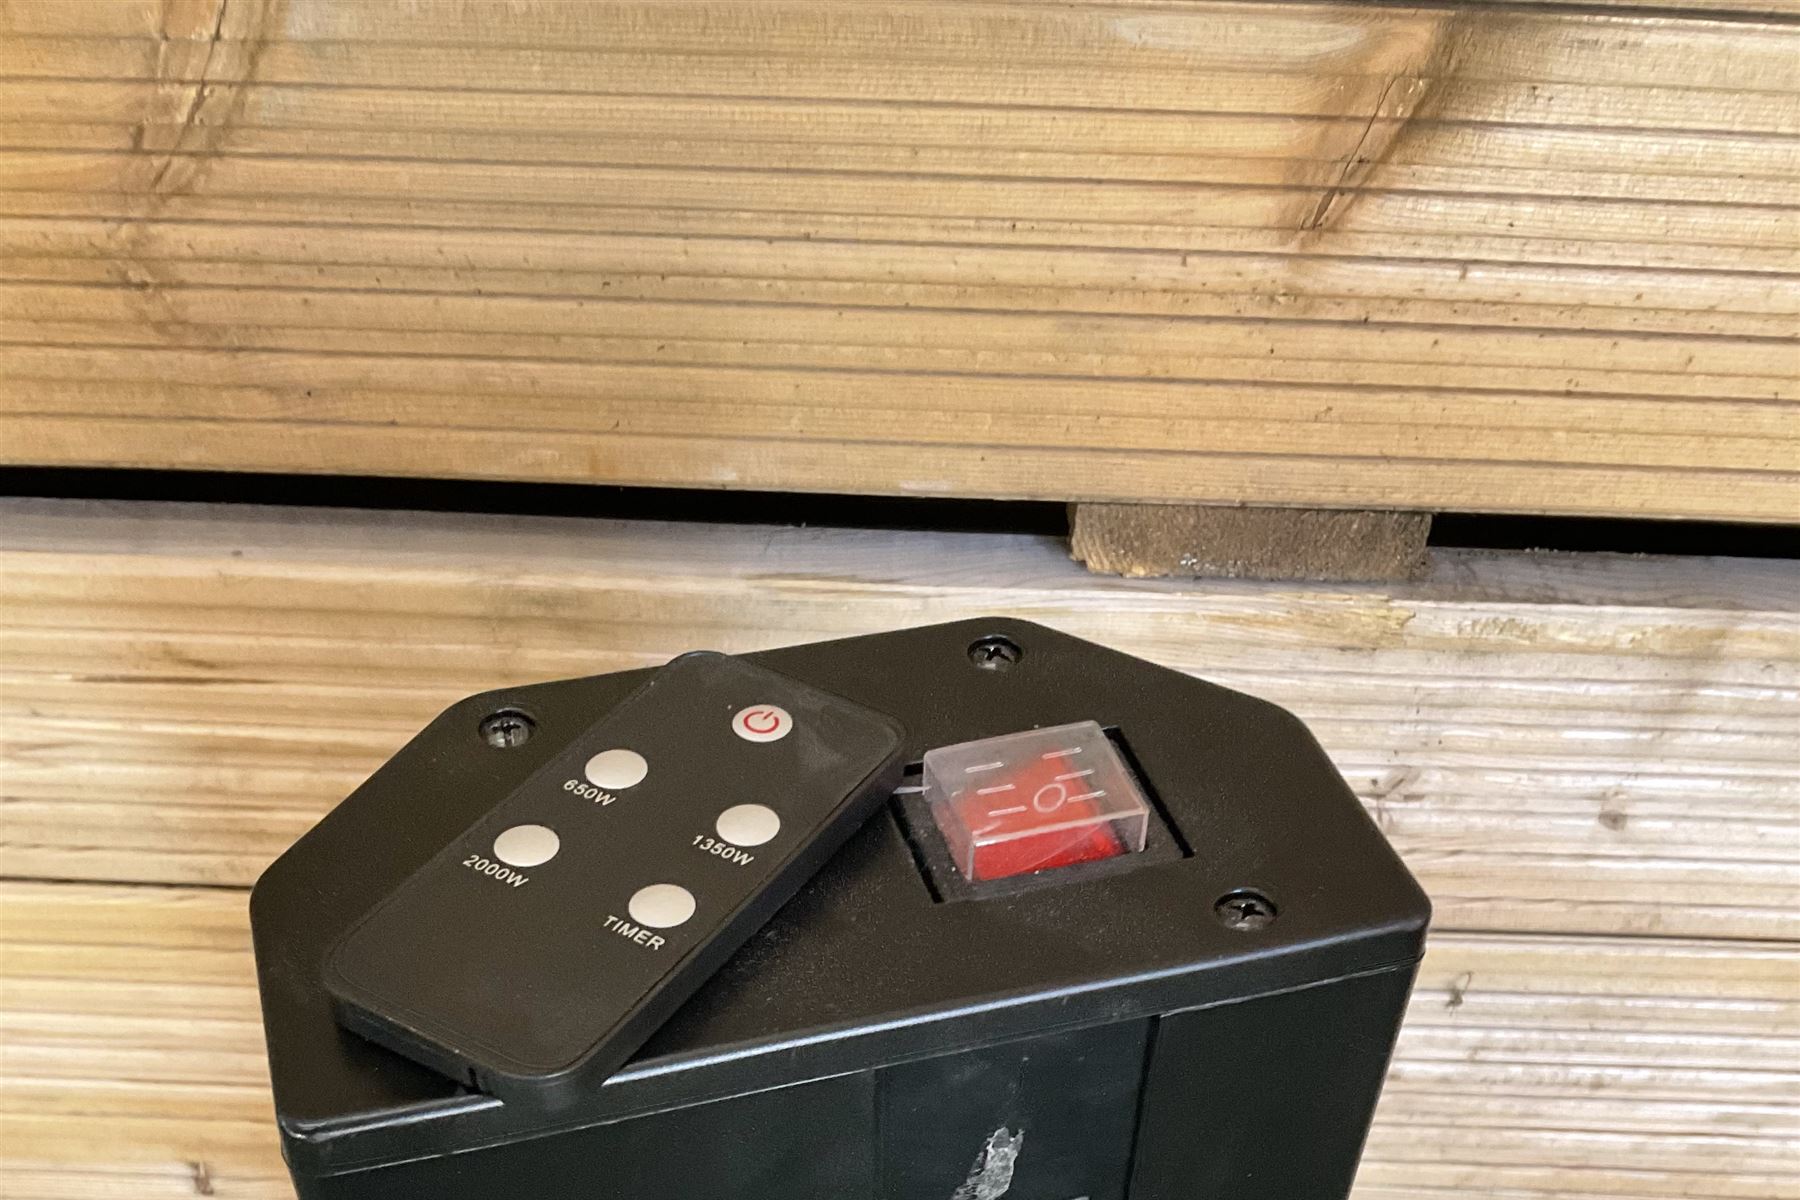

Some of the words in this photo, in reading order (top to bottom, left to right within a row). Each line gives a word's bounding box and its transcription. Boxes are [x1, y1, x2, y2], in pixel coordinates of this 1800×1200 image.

[563, 779, 616, 806] 650W
[692, 834, 754, 866] 1350W
[462, 855, 529, 888] 2000W
[603, 915, 665, 951] TIMER
